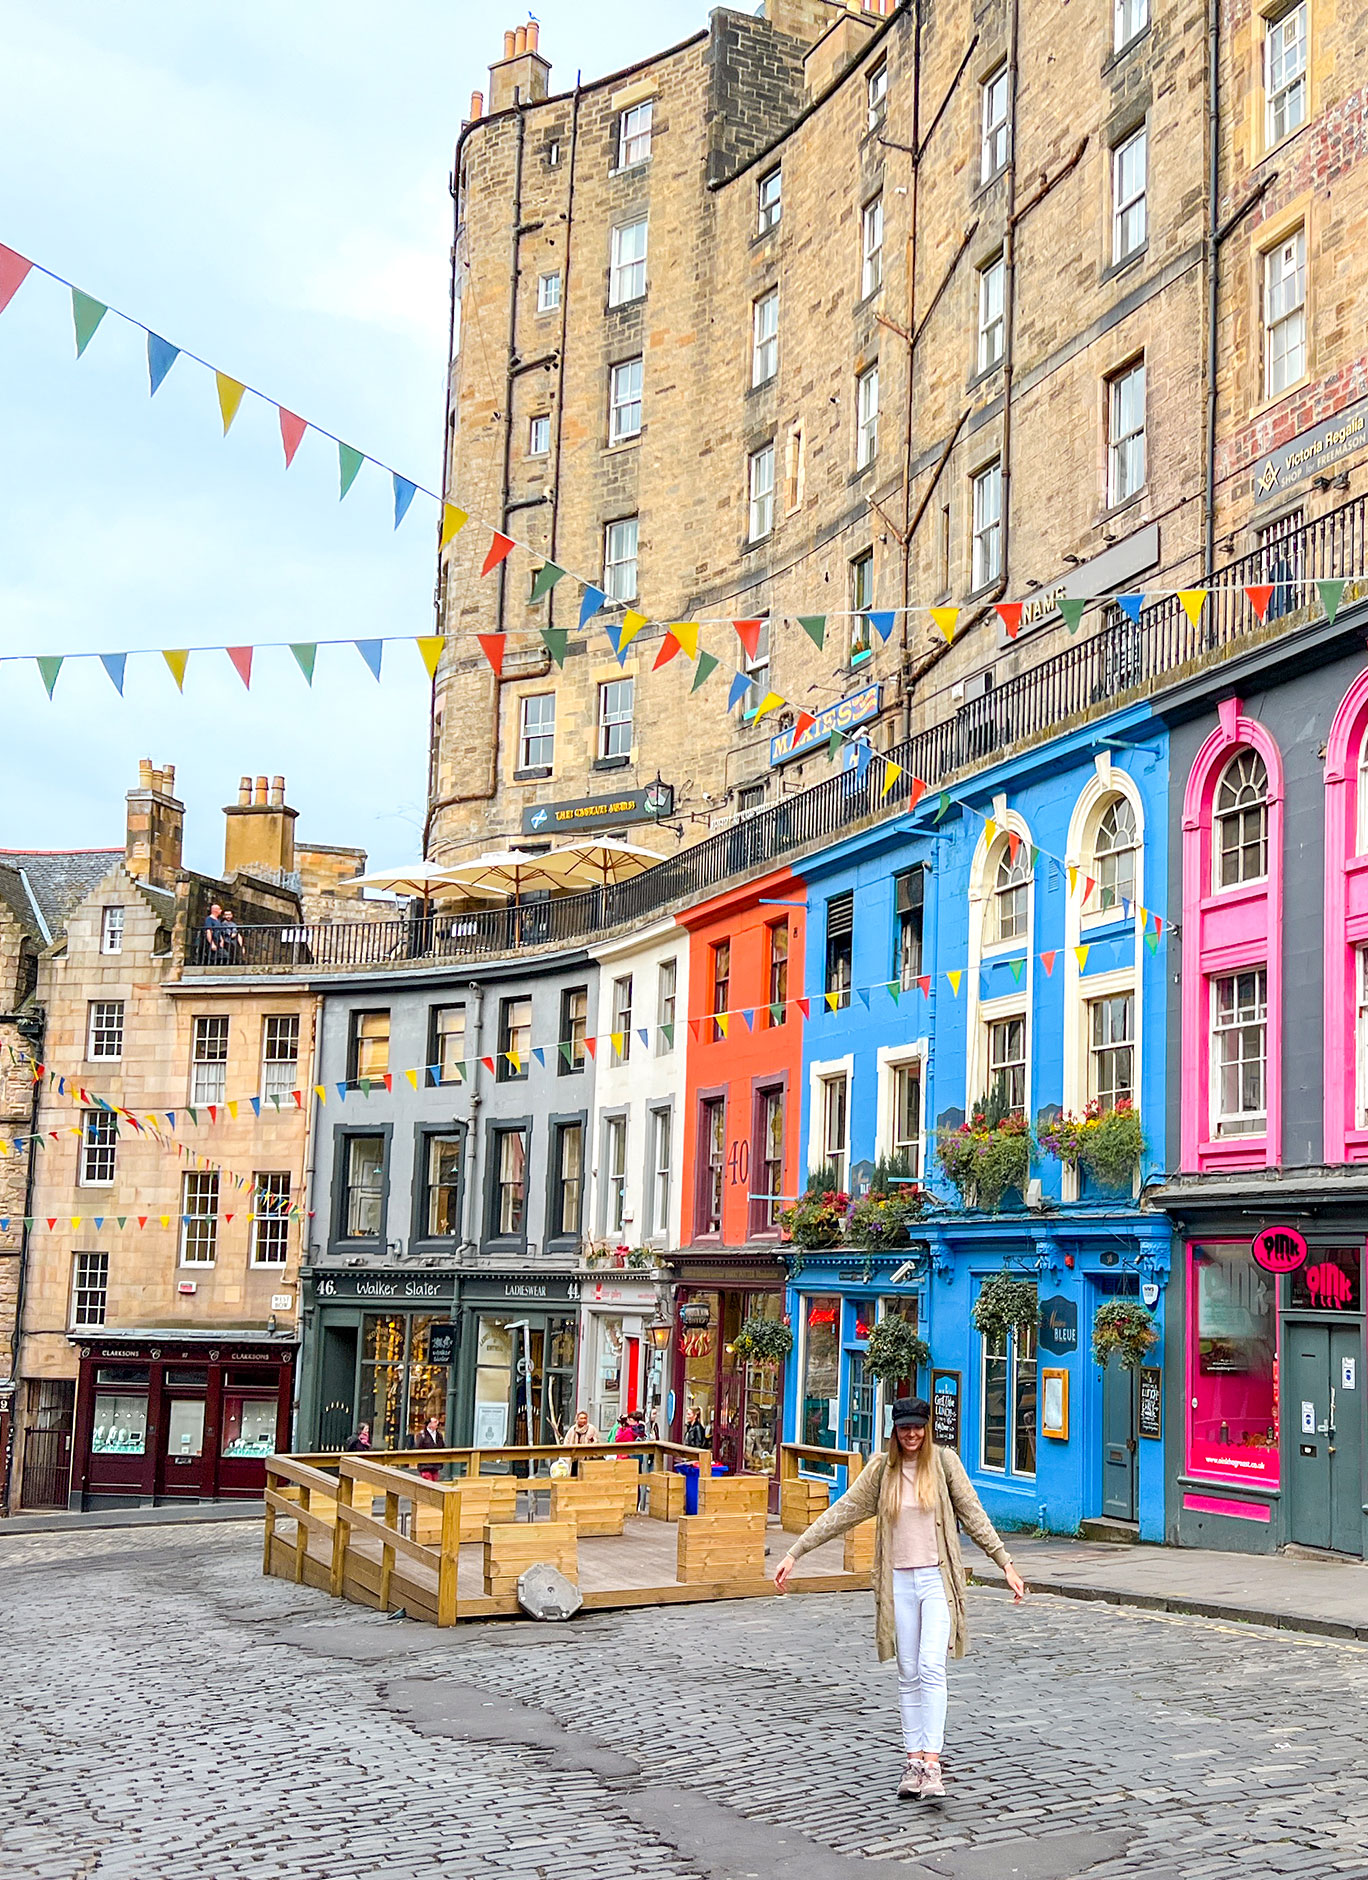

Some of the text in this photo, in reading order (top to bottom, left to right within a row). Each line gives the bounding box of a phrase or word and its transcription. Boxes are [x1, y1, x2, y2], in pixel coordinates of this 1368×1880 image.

[1285, 417, 1365, 470] Victoria Regalia
[1281, 469, 1302, 488] SHOP
[728, 1139, 749, 1185] 40
[356, 1281, 398, 1295] Walker
[405, 1280, 441, 1295] Slater
[505, 1285, 546, 1296] LADIESWEAR
[1054, 1328, 1077, 1341] BLEUE
